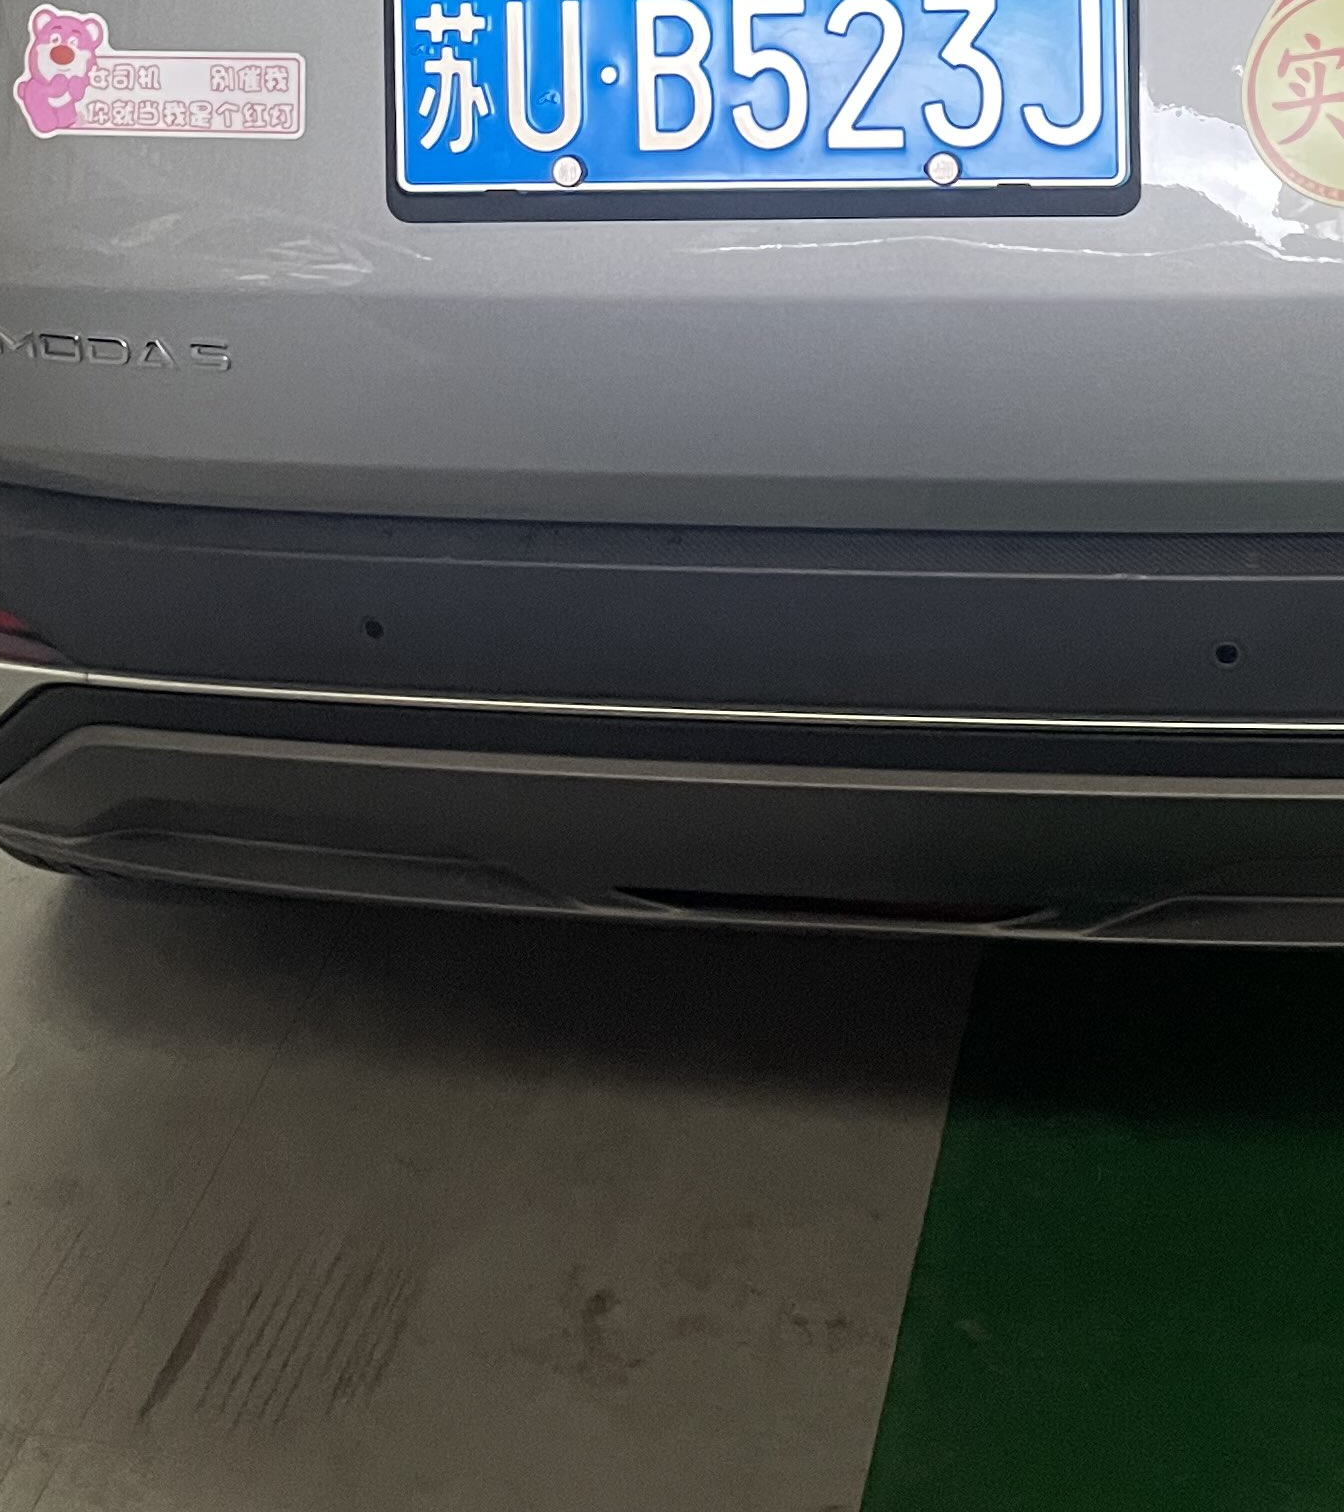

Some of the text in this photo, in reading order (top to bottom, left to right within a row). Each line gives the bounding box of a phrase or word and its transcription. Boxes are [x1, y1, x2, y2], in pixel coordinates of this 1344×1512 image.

[87, 63, 290, 93] 女司机 别催我
[86, 99, 294, 130] 你就当我是个红灯
